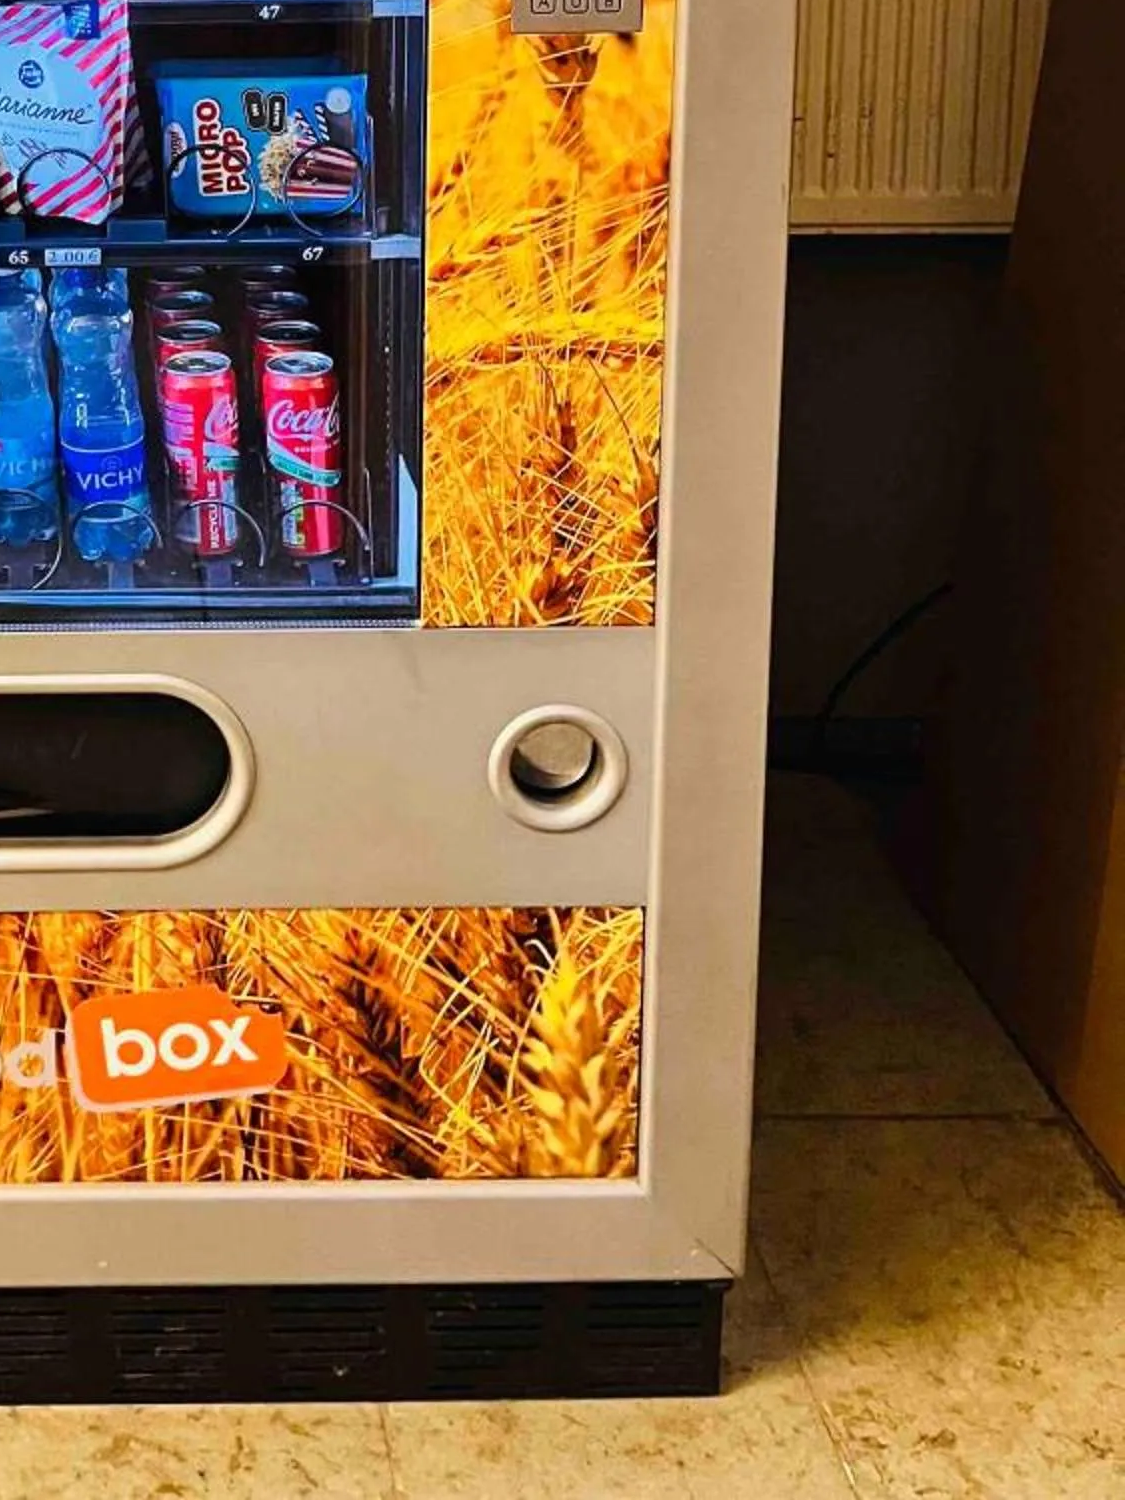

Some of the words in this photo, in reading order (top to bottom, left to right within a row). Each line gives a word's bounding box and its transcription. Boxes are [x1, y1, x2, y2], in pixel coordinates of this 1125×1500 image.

[258, 4, 281, 21] 47
[195, 101, 224, 195] MICRO
[222, 129, 249, 193] POP
[7, 249, 29, 265] 65
[302, 246, 324, 262] 67
[75, 463, 144, 492] VICHY
[100, 1016, 259, 1079] box
